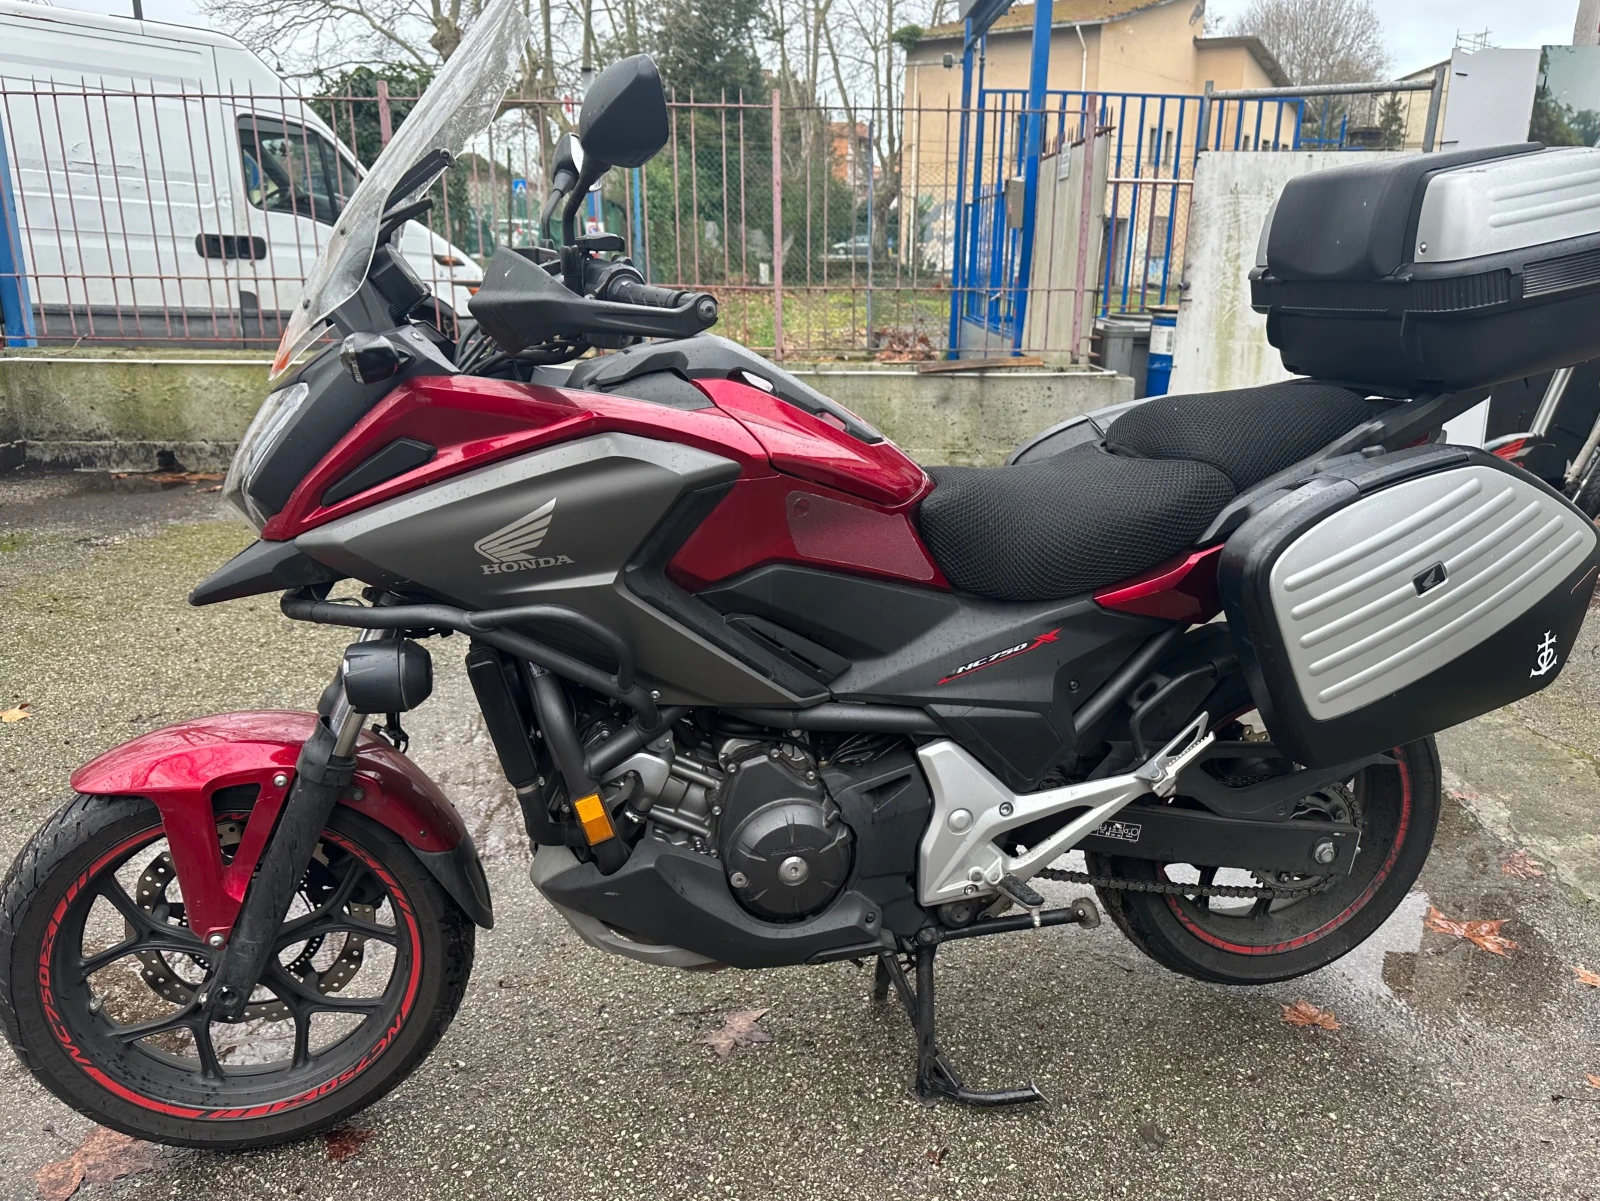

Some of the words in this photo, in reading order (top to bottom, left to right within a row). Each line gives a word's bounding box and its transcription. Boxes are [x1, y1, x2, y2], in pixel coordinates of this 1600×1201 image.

[480, 554, 575, 575] HONDA
[39, 919, 93, 1066] NC750X
[269, 1013, 402, 1113] NC750X
